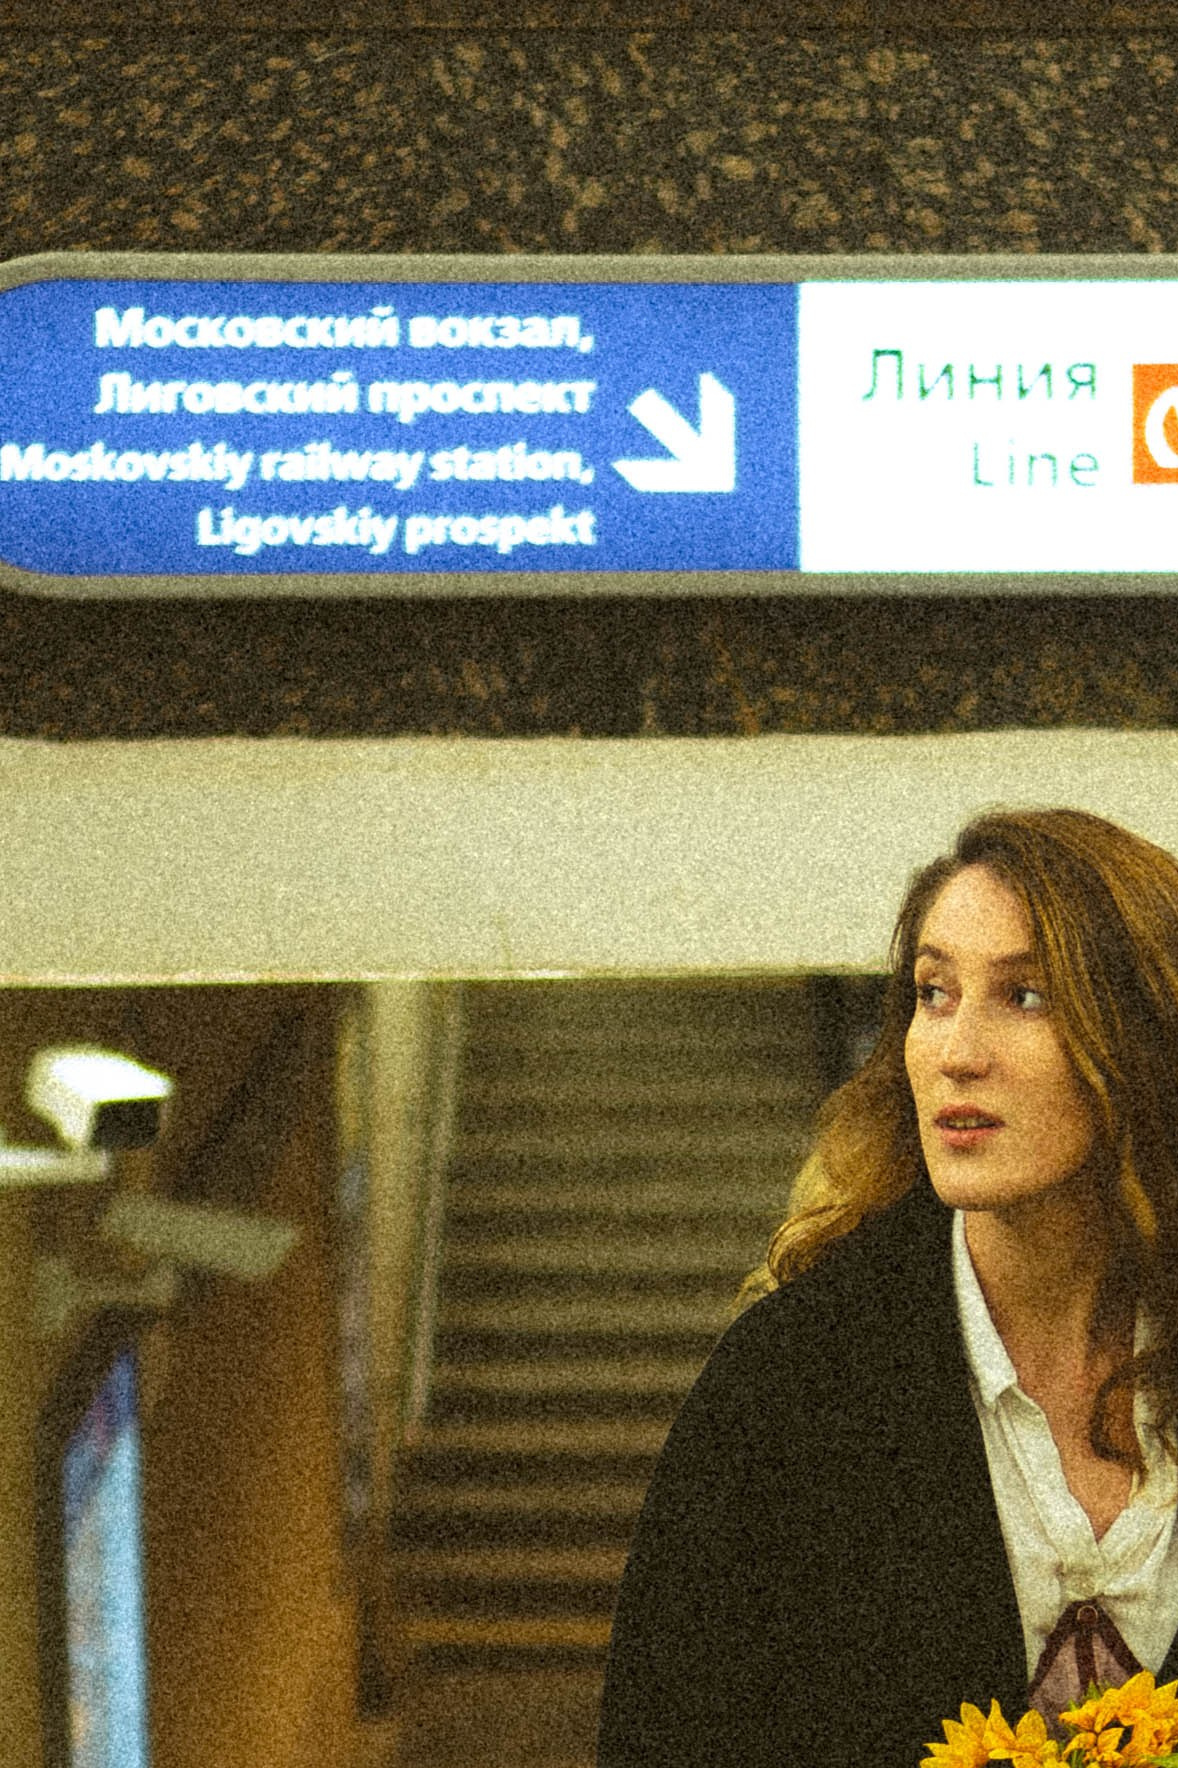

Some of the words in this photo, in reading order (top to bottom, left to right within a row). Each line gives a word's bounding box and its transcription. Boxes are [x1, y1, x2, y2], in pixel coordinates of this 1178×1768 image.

[94, 305, 399, 349] Московский
[409, 315, 595, 352] вокзал,
[94, 370, 358, 414] Лиговский
[368, 379, 596, 424] проспект
[862, 347, 1098, 401] Линия
[0, 441, 251, 490] Moskovskiy
[260, 441, 421, 490] railway
[430, 444, 595, 486] station,
[972, 442, 1099, 487] Line
[197, 506, 397, 555] Ligovskiy
[405, 505, 596, 553] prospekt
